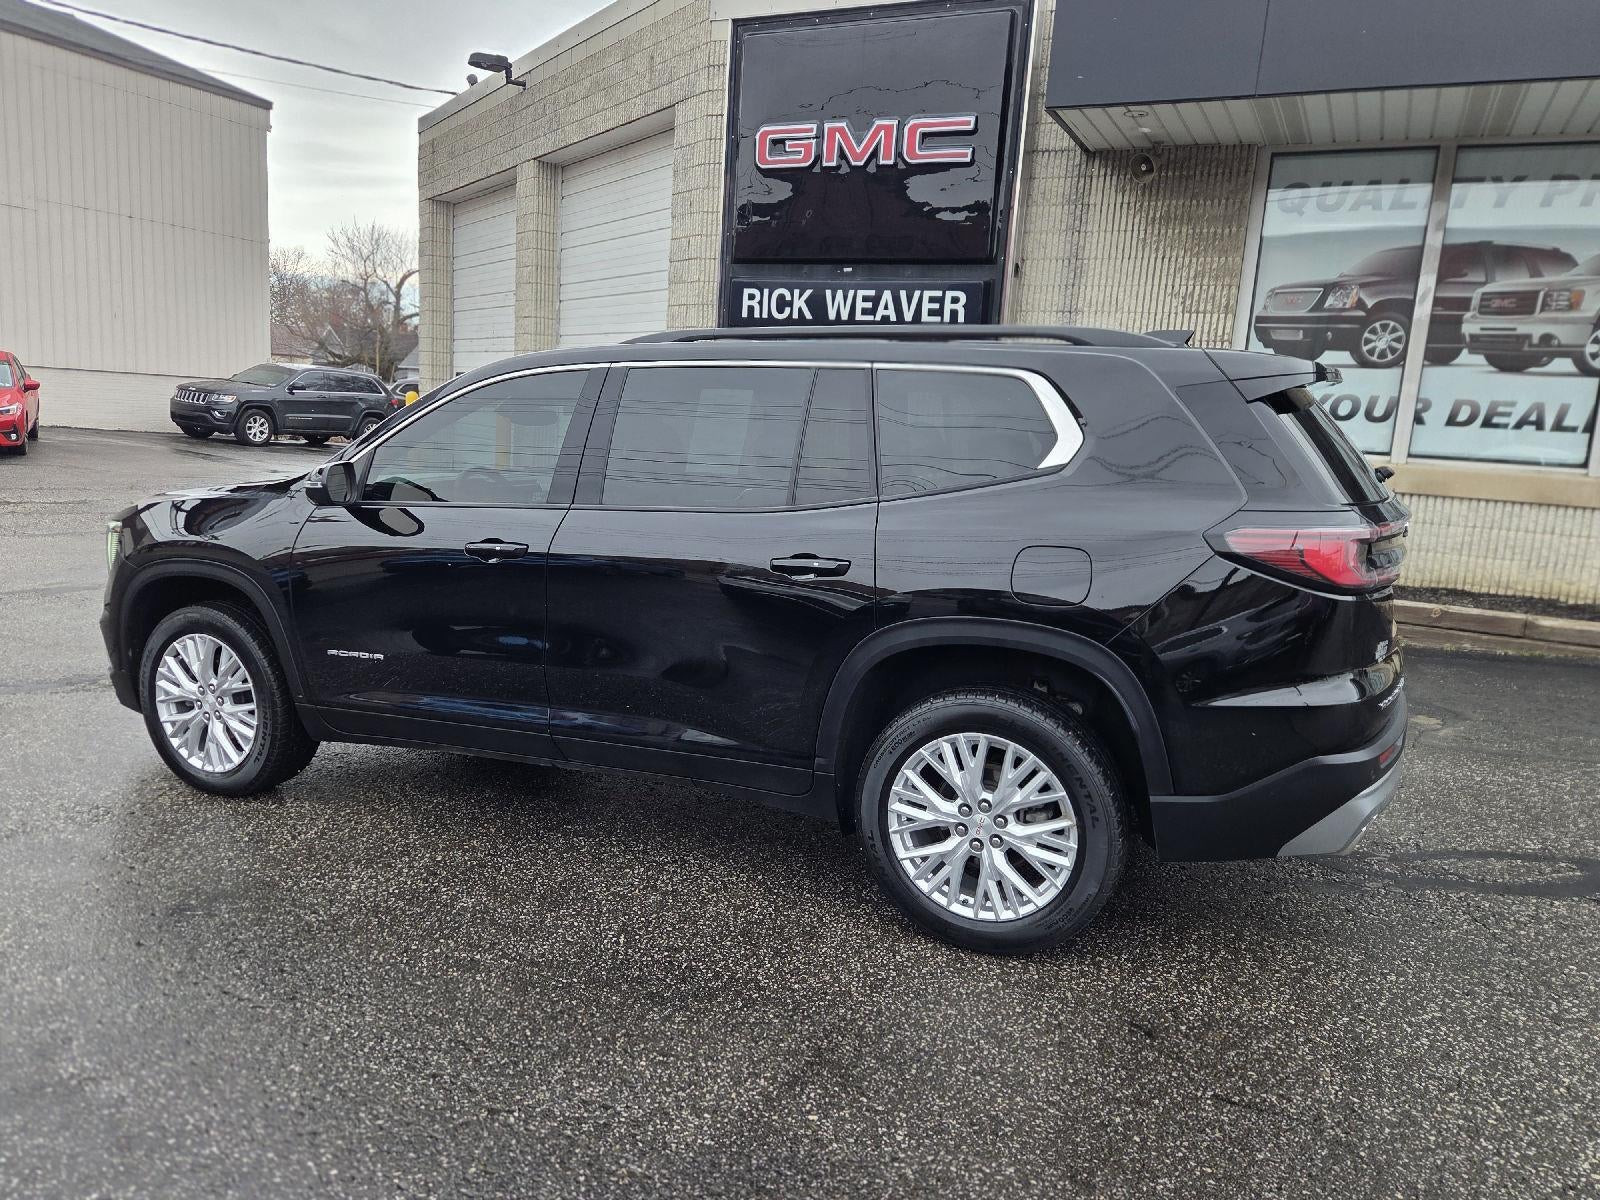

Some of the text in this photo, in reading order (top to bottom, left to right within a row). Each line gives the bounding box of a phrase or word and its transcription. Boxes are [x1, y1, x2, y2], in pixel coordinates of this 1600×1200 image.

[755, 112, 979, 169] GMC
[1276, 174, 1529, 216] QUALTY
[741, 287, 967, 323] RICK WEAVER
[326, 649, 384, 661] ACADIA
